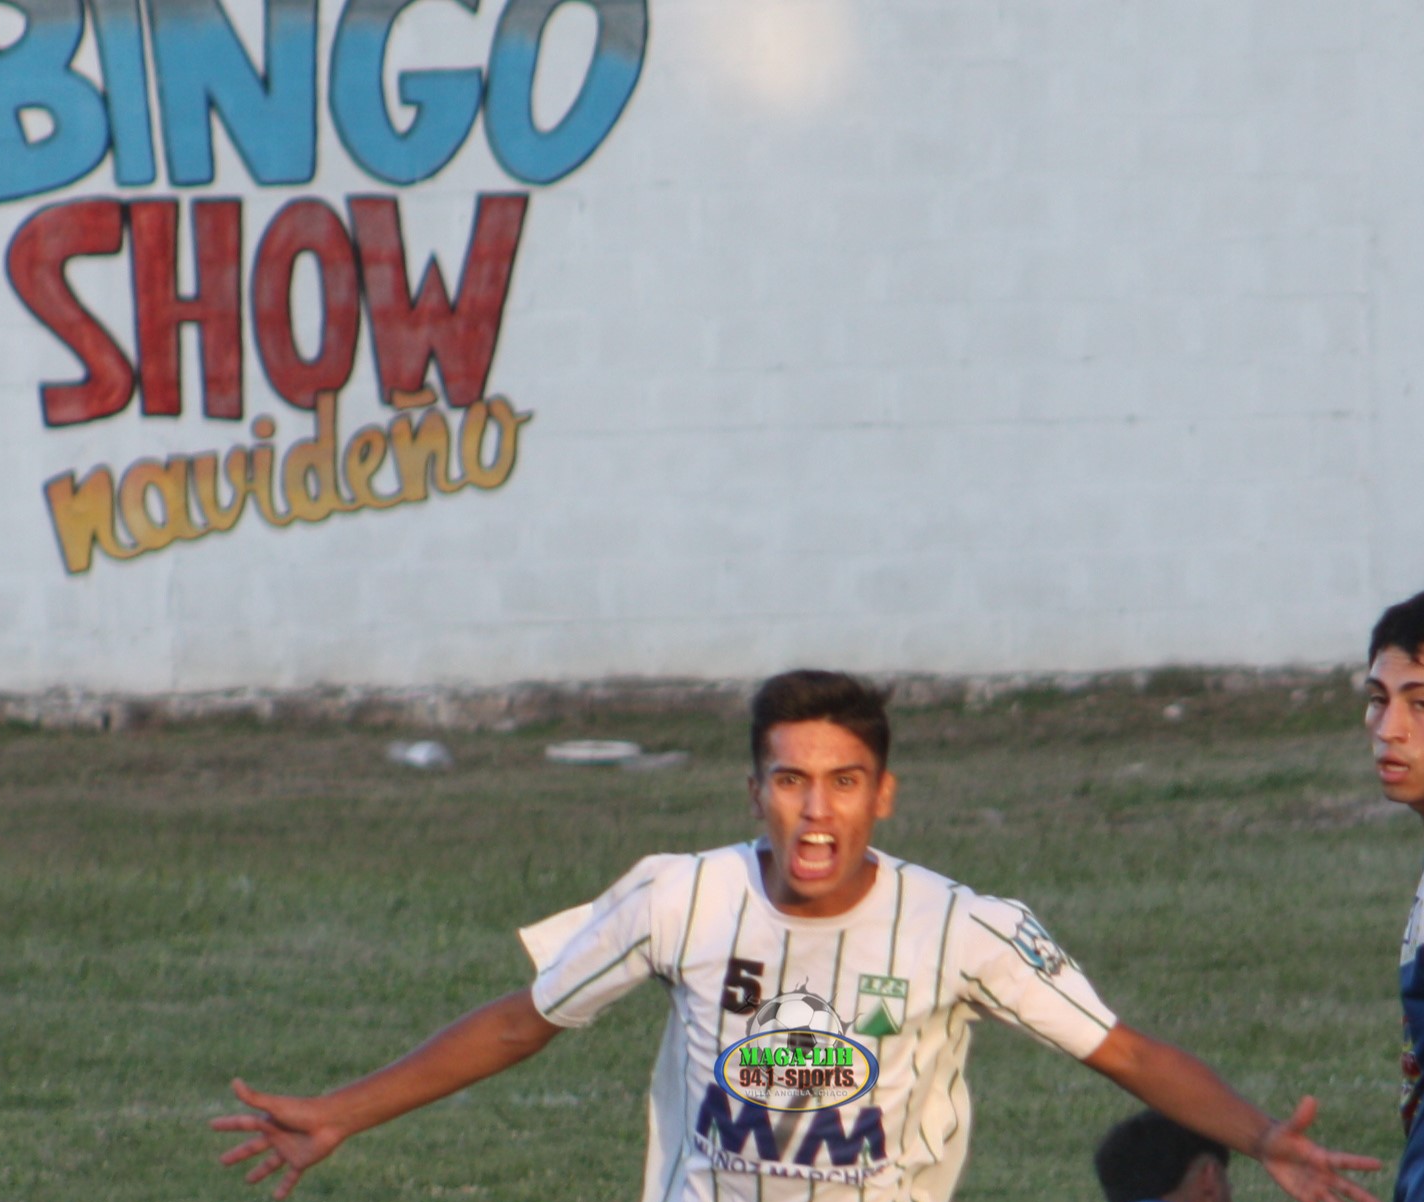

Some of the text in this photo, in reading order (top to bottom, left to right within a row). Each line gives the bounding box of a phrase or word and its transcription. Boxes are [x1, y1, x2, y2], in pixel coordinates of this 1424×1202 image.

[5, 192, 530, 427] SHOW
[43, 390, 533, 574] navideño
[721, 957, 764, 1015] 5
